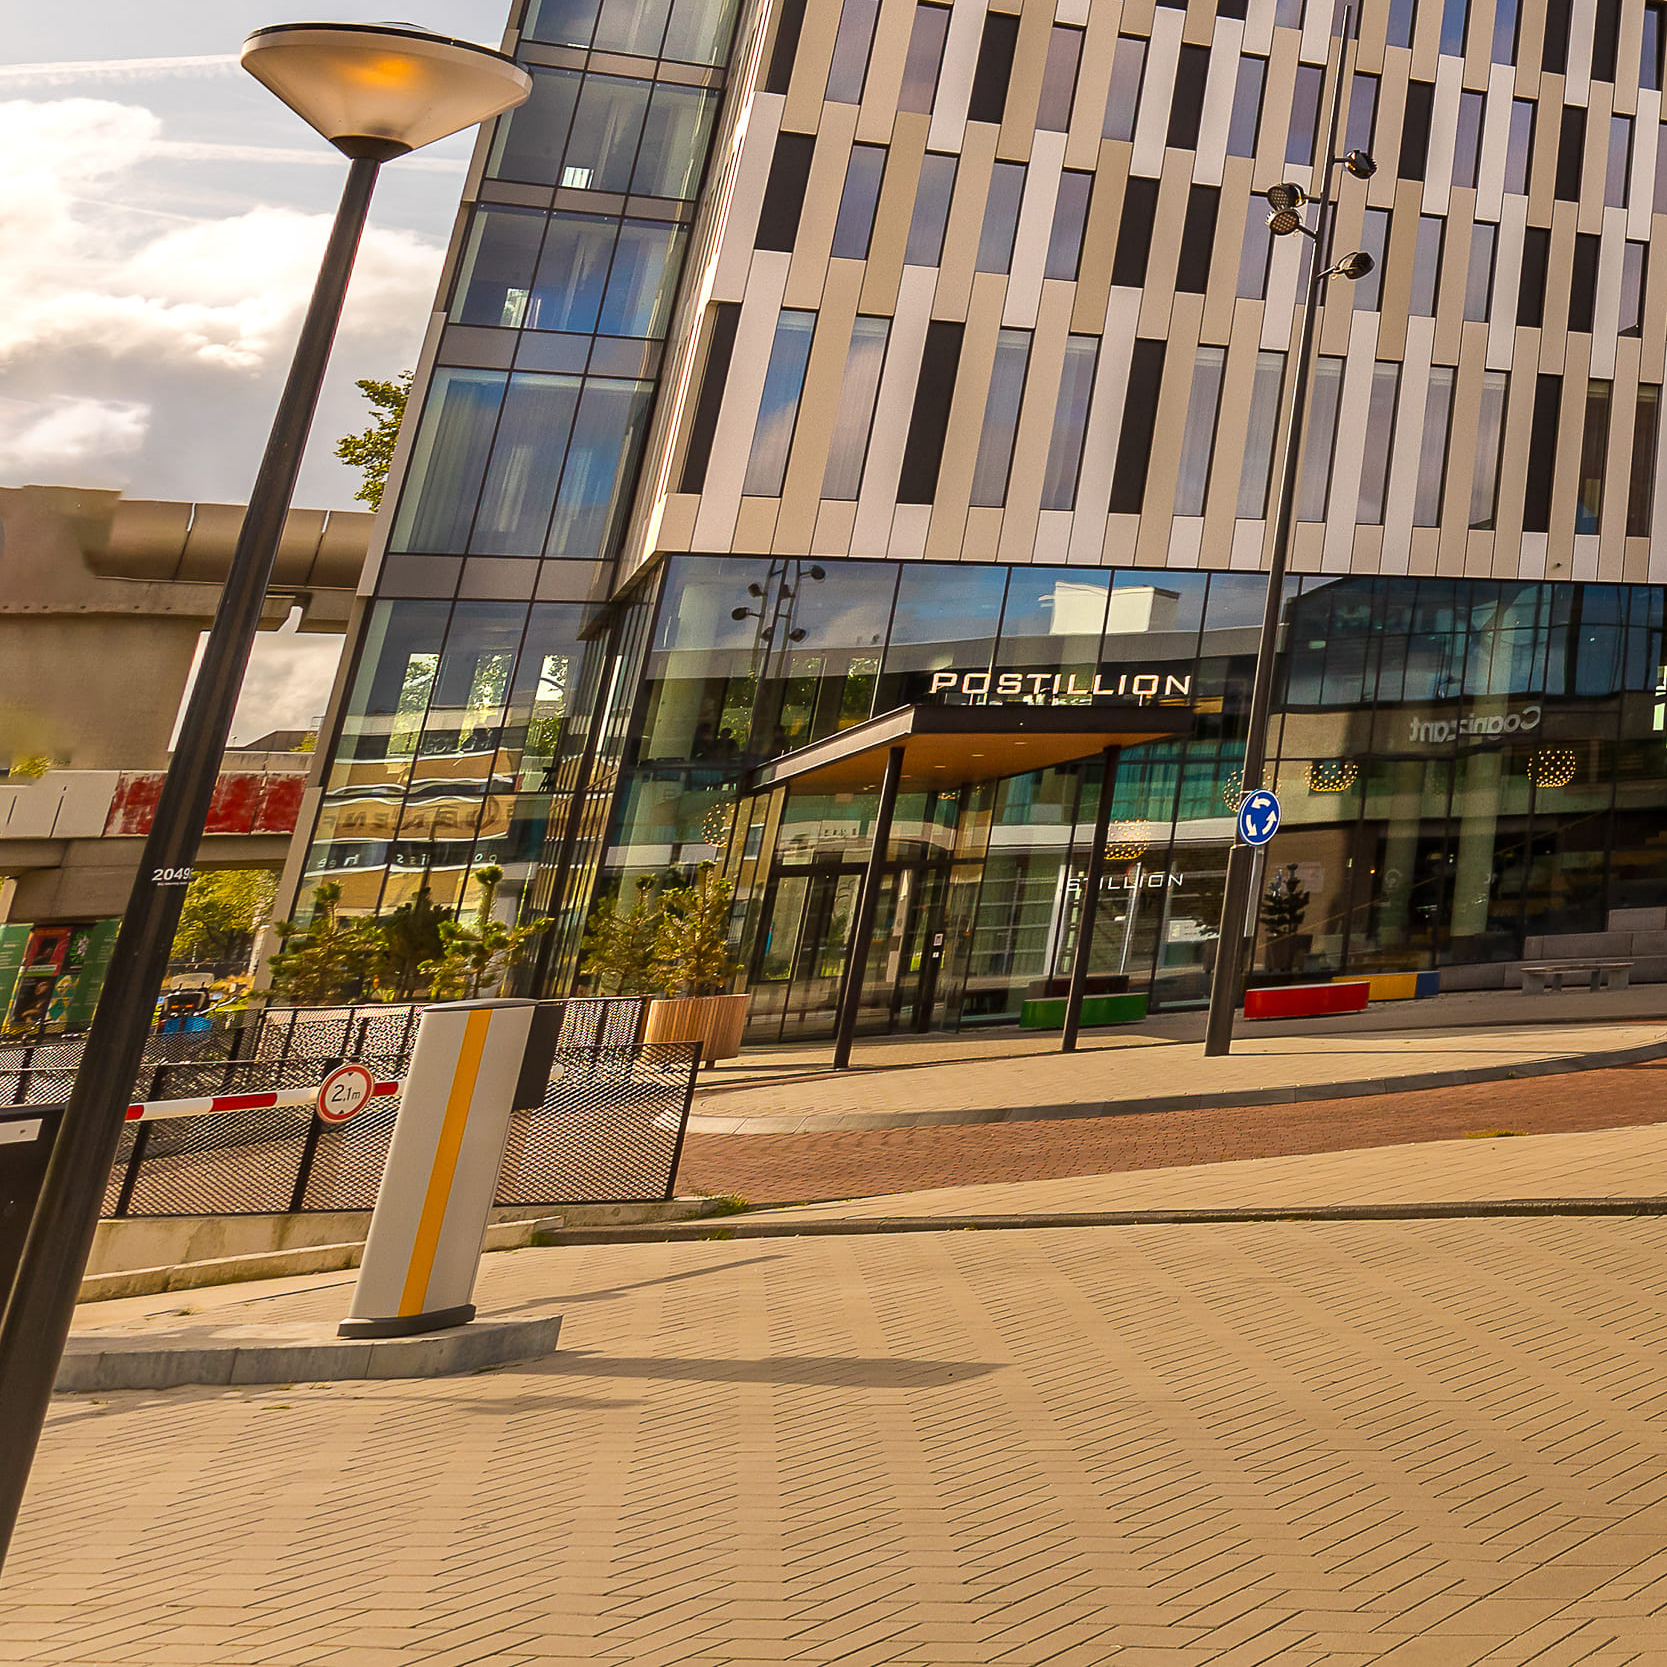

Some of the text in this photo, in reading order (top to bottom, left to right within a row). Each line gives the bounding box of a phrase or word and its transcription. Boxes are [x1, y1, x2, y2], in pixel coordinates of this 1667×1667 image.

[928, 672, 1192, 695] POSTILLION
[151, 867, 194, 881] 2049
[1067, 873, 1184, 892] SILLION
